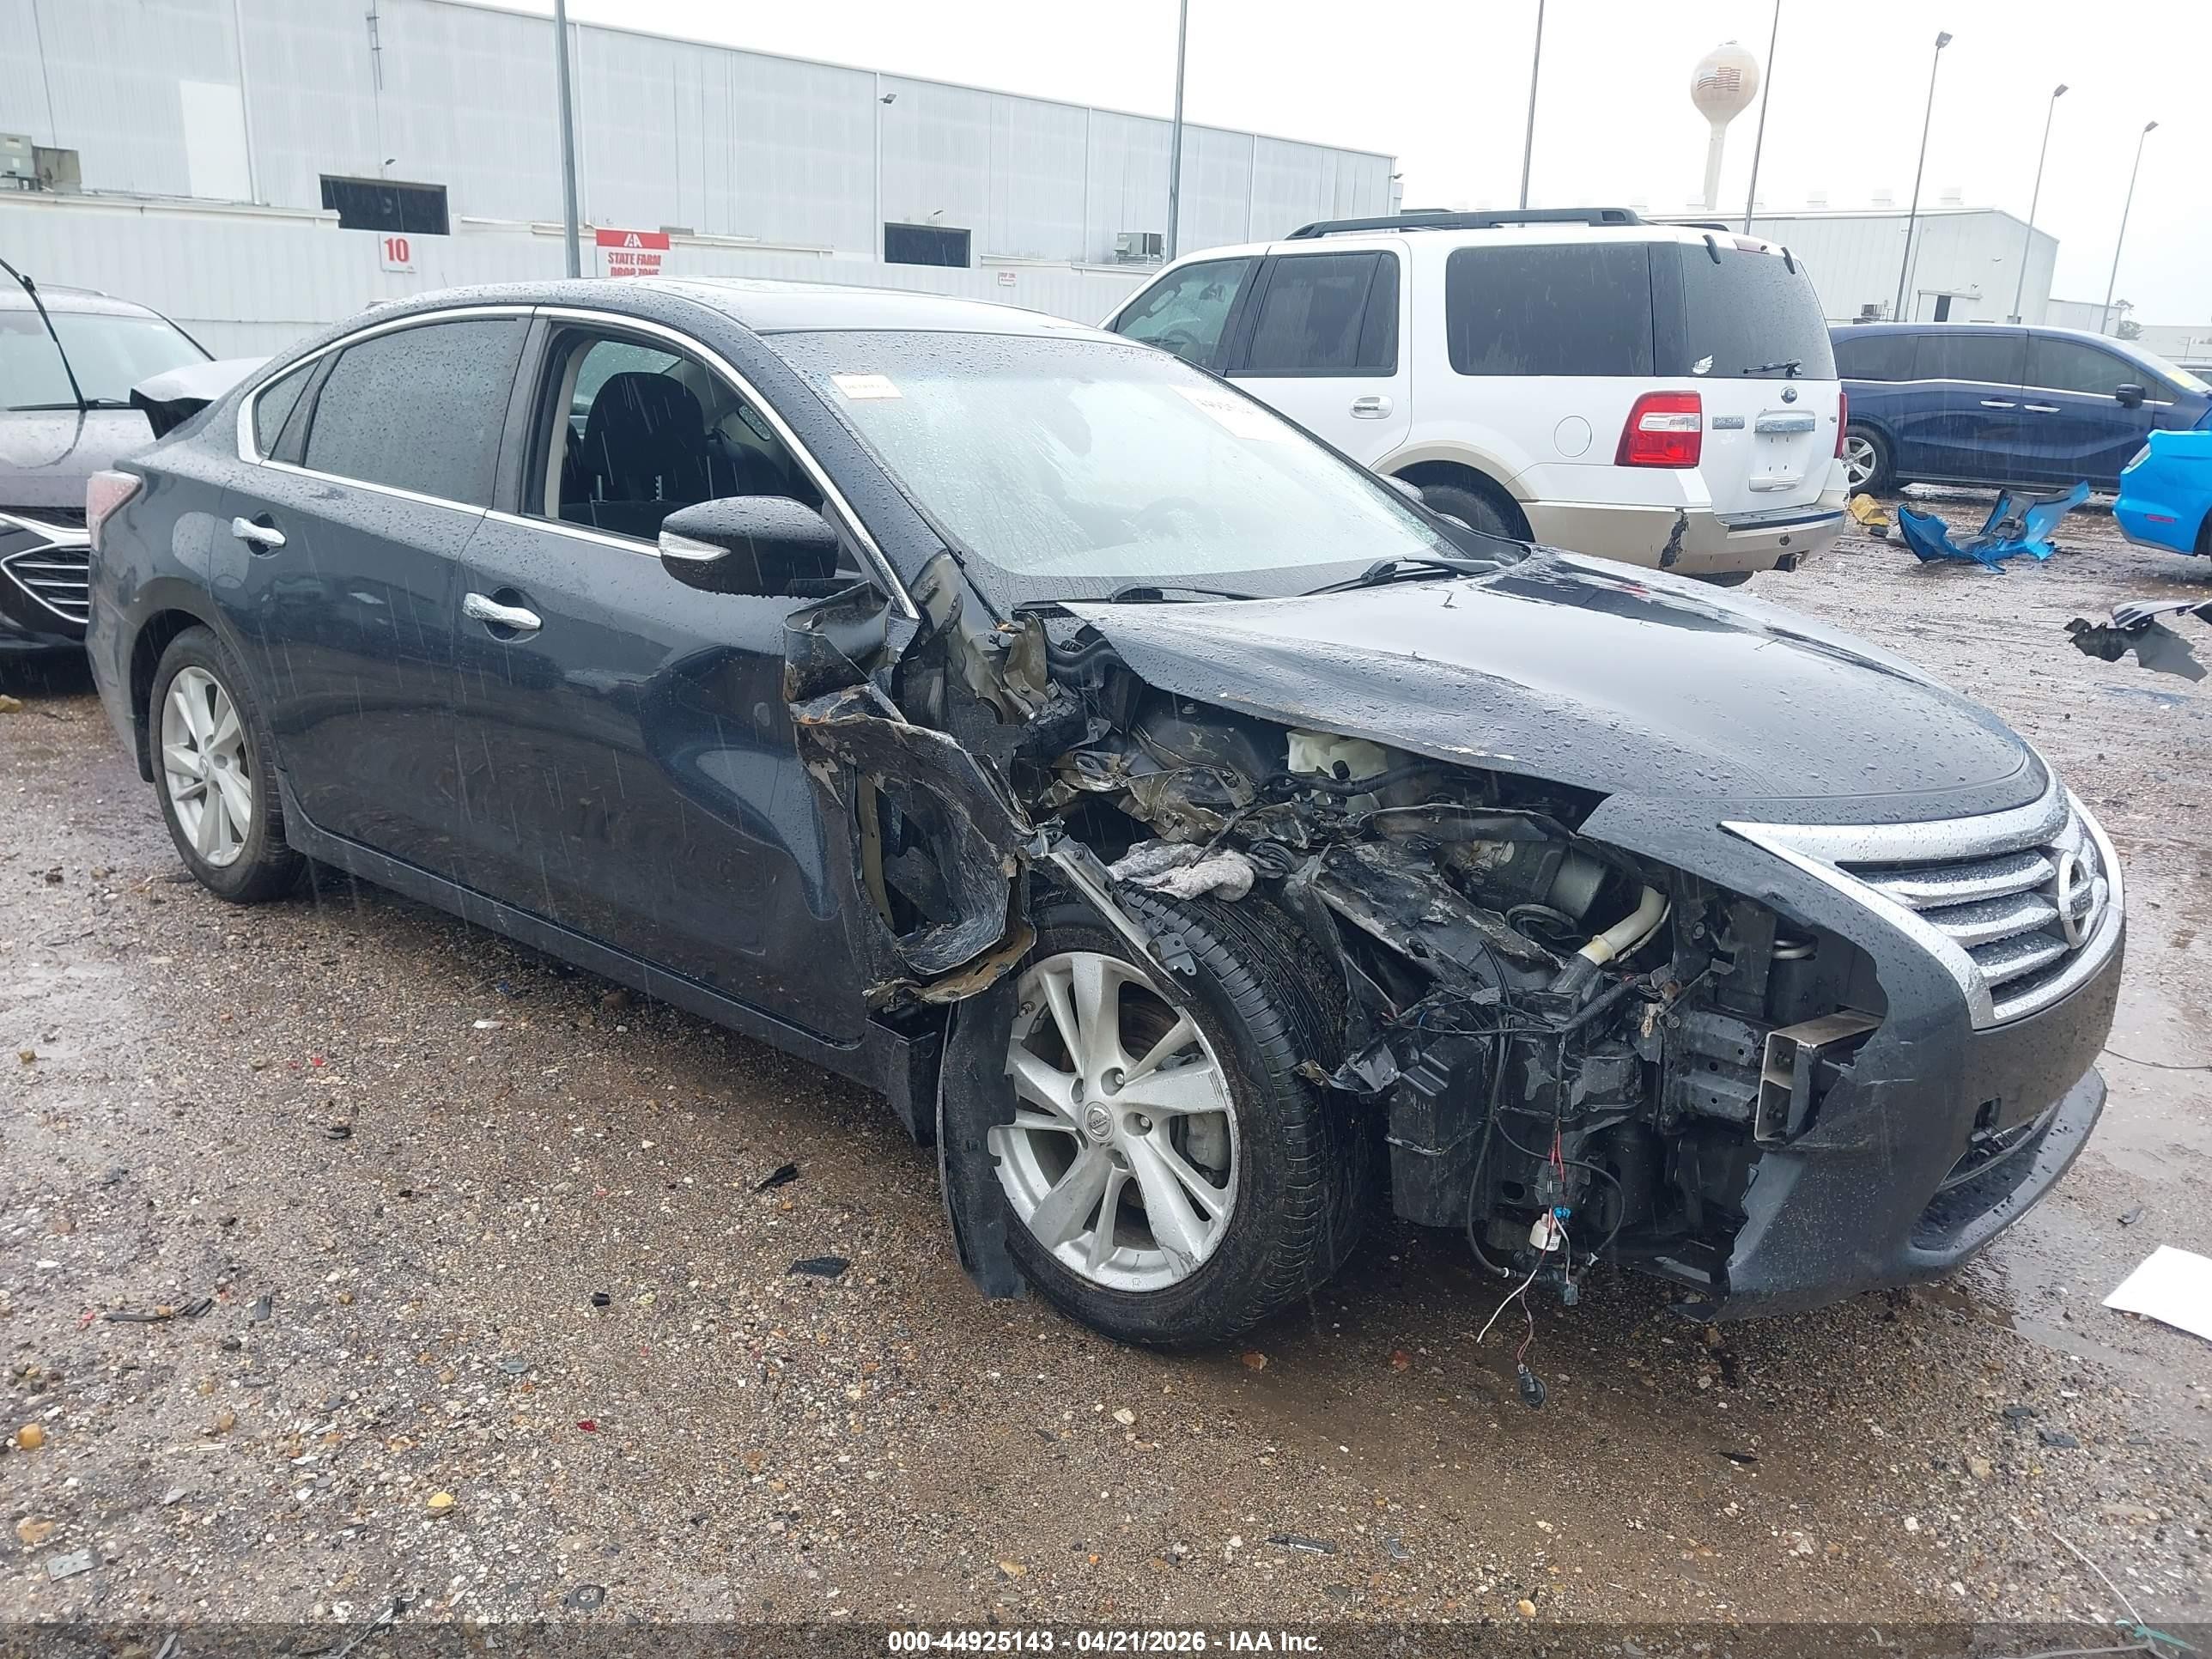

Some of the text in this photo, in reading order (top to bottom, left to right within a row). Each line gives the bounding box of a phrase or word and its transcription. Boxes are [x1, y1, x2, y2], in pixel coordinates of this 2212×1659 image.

[384, 237, 410, 263] 10
[608, 252, 661, 266] STATE FARM
[611, 266, 635, 276] DROP
